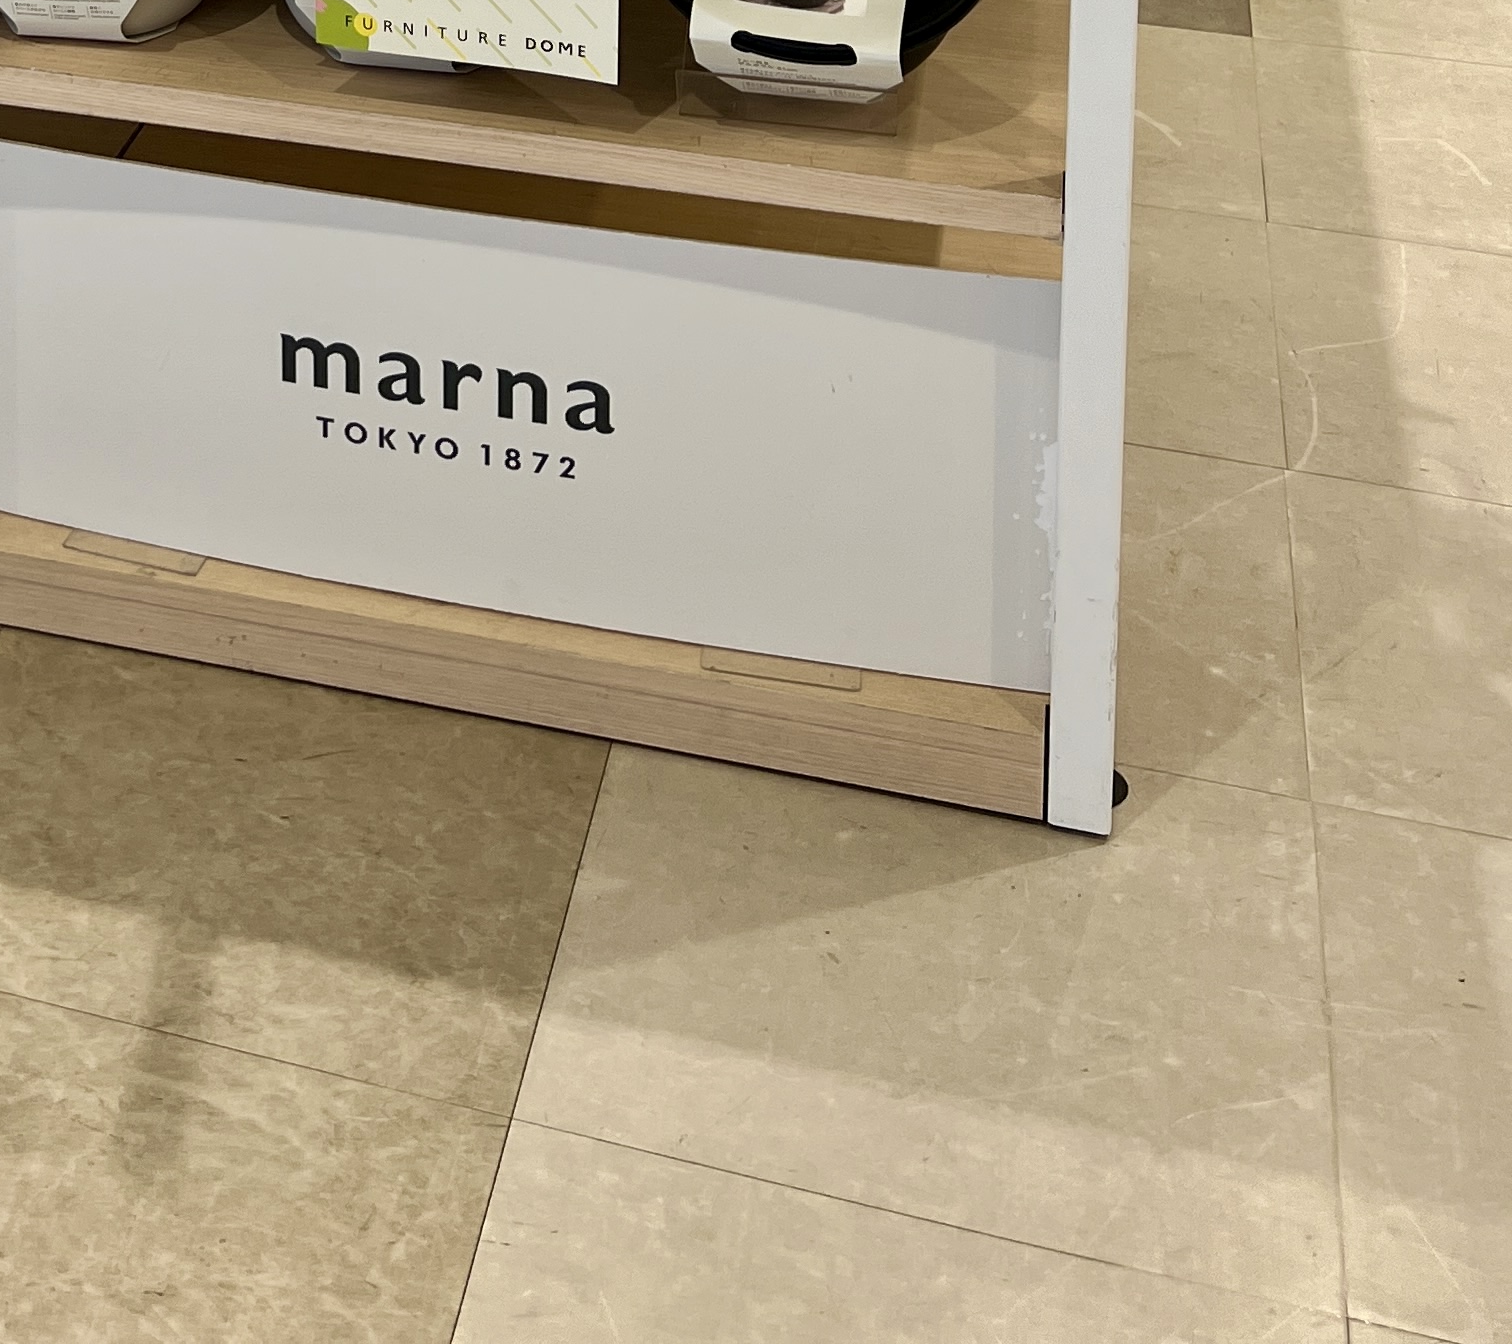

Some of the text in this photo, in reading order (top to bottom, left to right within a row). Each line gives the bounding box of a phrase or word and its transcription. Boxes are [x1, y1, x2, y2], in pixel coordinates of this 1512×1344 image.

[345, 13, 588, 60] FURNITURE DOME
[280, 332, 616, 435] marna
[316, 414, 577, 480] TOKYO 1872
